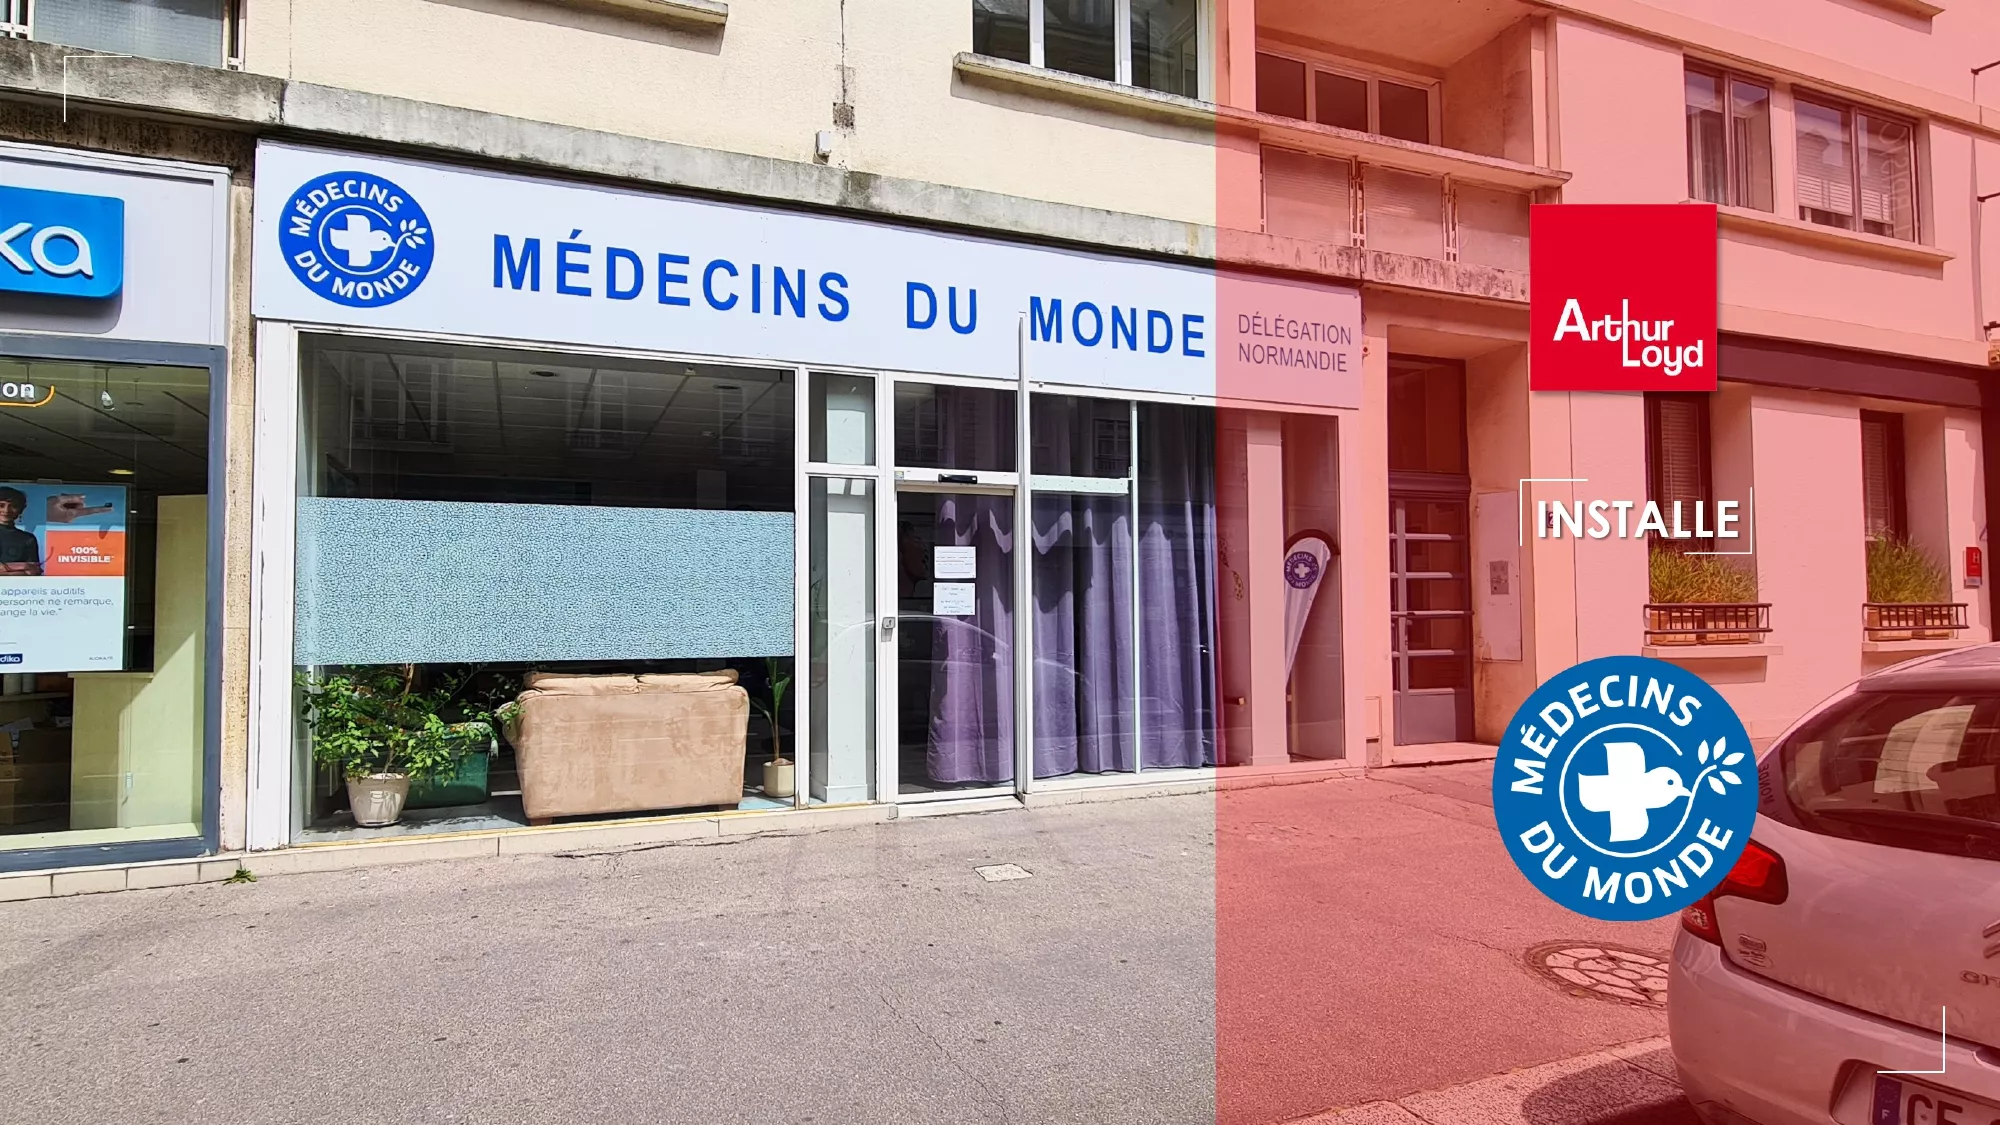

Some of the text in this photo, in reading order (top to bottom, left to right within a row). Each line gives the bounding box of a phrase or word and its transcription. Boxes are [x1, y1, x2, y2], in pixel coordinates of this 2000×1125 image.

[289, 179, 404, 237] MÉDECINS
[293, 250, 421, 300] DU MONDE
[493, 228, 1206, 358] MÉDECINS DU MONDE
[1238, 311, 1352, 346] DÉLÉGATION
[1238, 343, 1348, 372] NORMANDIE
[70, 546, 99, 554] 100%
[1, 587, 85, 597] appareils auditifs
[47, 598, 61, 606] ne
[29, 608, 38, 616] la
